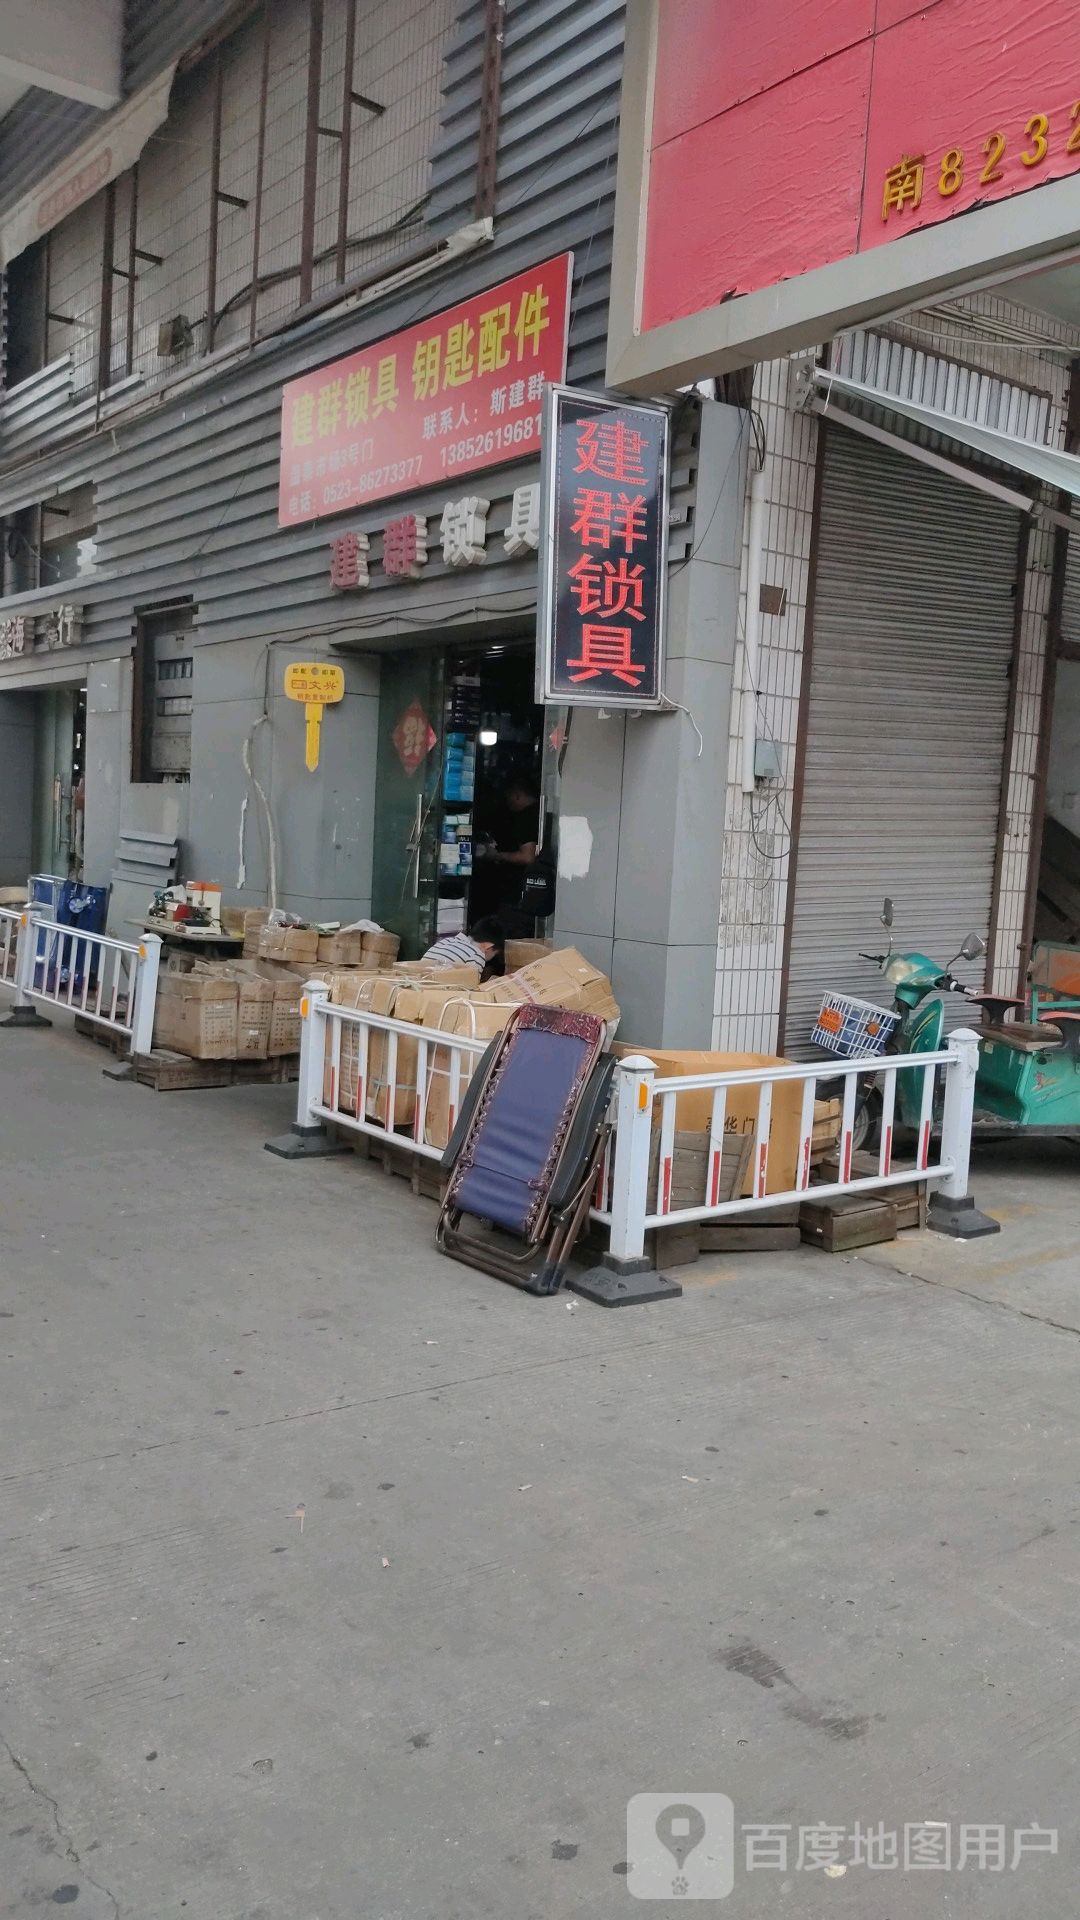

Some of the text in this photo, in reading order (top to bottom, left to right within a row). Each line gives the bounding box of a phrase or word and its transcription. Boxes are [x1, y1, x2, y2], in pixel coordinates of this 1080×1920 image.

[290, 284, 550, 449] 建群锁具 钥匙配件
[440, 414, 543, 467] 13852619681
[566, 419, 650, 688] 建群锁具
